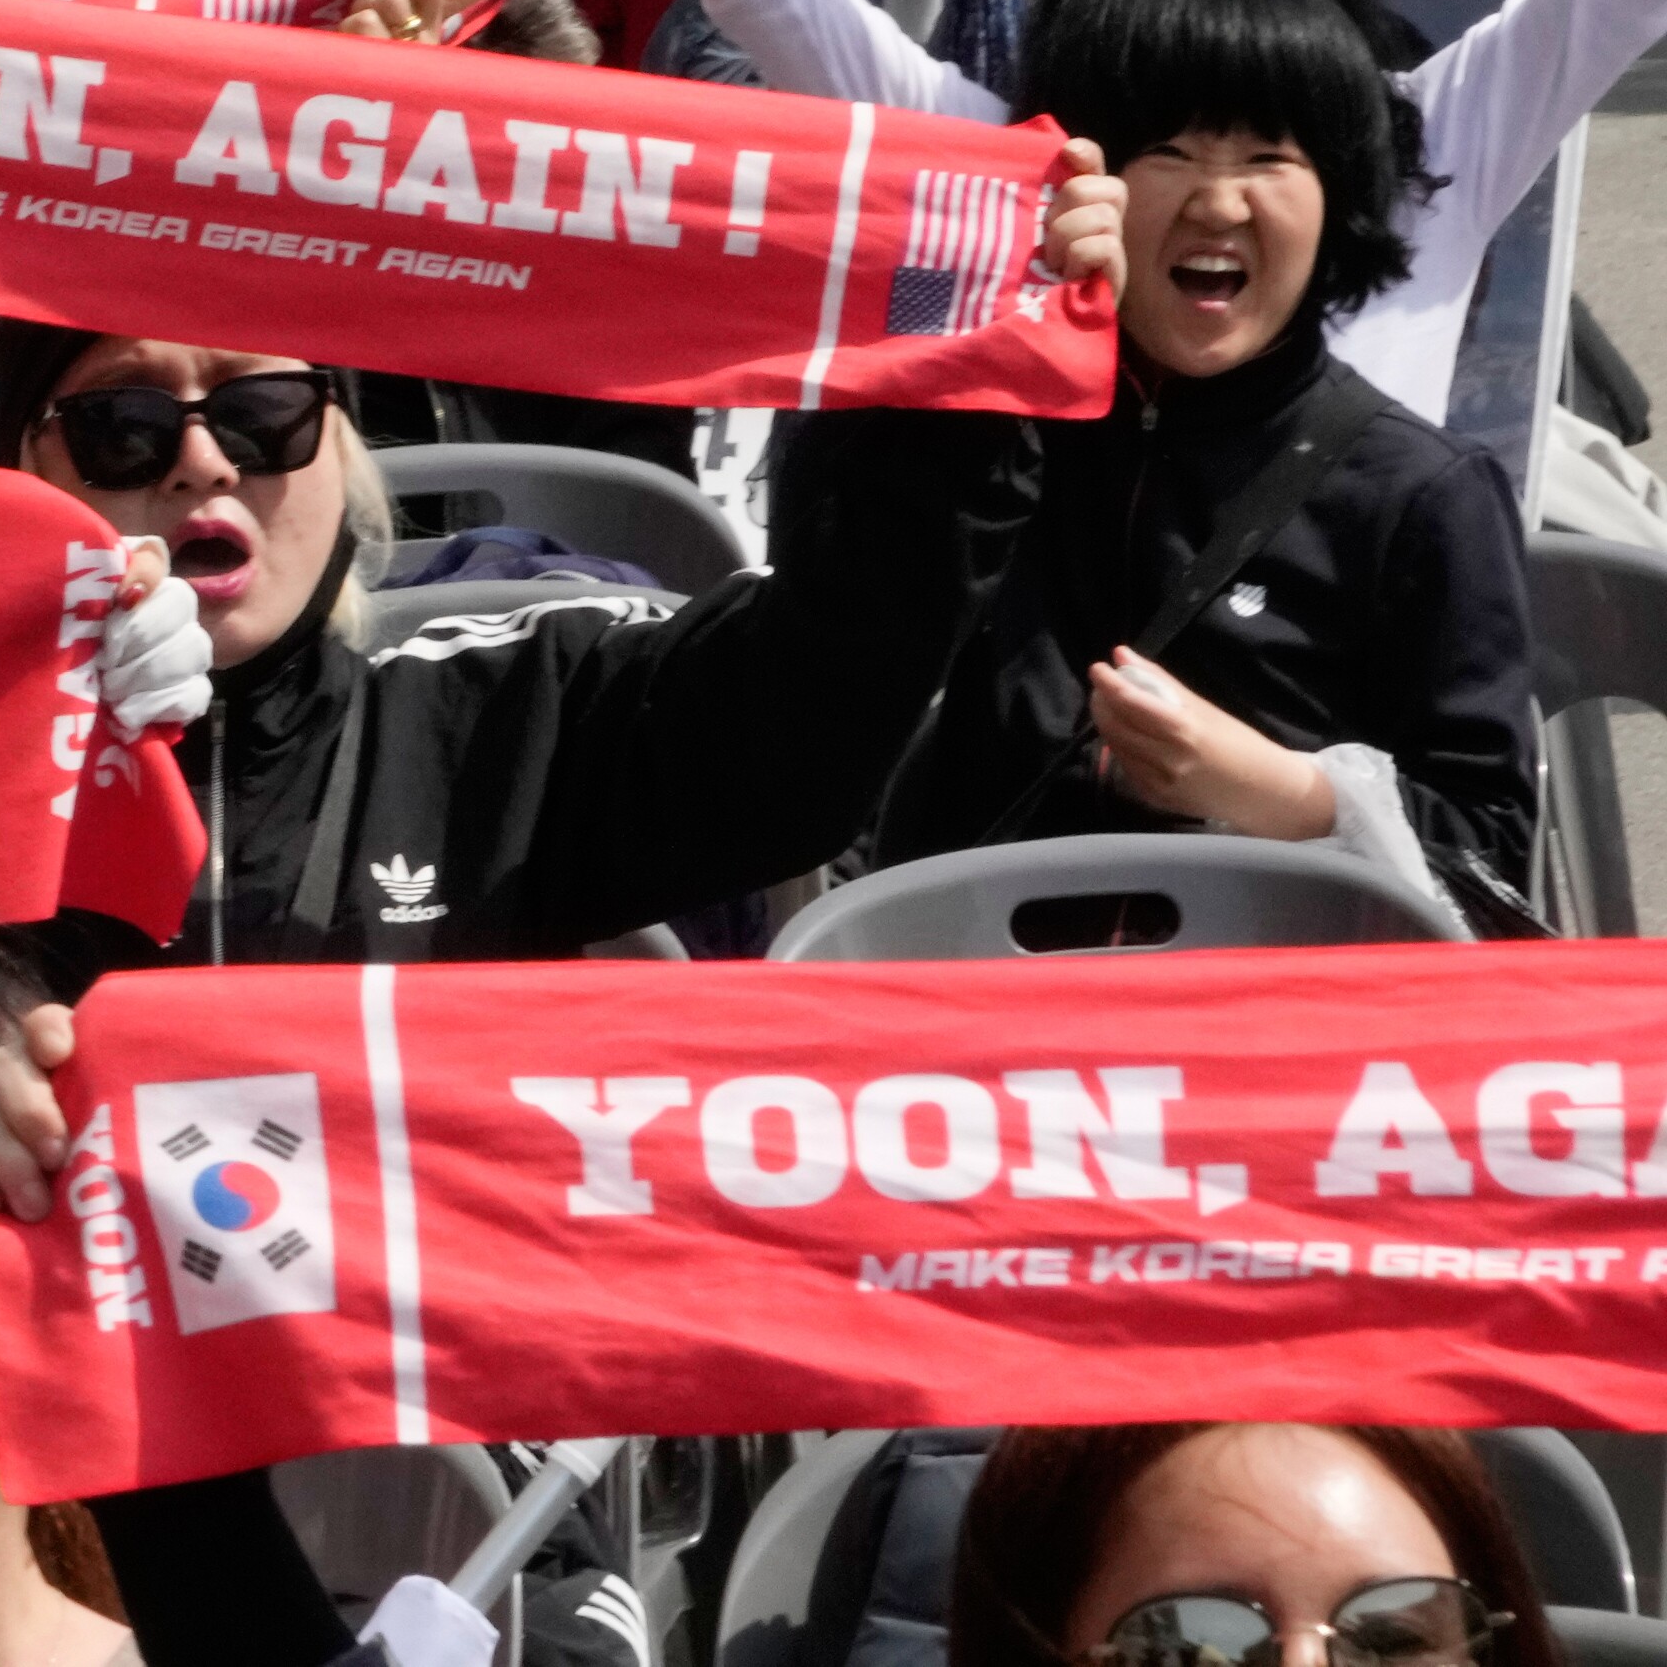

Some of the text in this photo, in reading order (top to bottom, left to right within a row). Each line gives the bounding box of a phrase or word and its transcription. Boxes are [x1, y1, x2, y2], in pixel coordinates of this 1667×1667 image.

[17, 194, 188, 247] KOREA
[197, 220, 372, 269] GREAT
[377, 246, 533, 292] AGAIN
[175, 80, 695, 248] AGAIN
[66, 1102, 151, 1333] YOON
[510, 1060, 1667, 1218] YOON, AG
[857, 1247, 1074, 1293] MAKE
[1090, 1241, 1353, 1284] KOREA
[1369, 1243, 1624, 1283] GREAT
